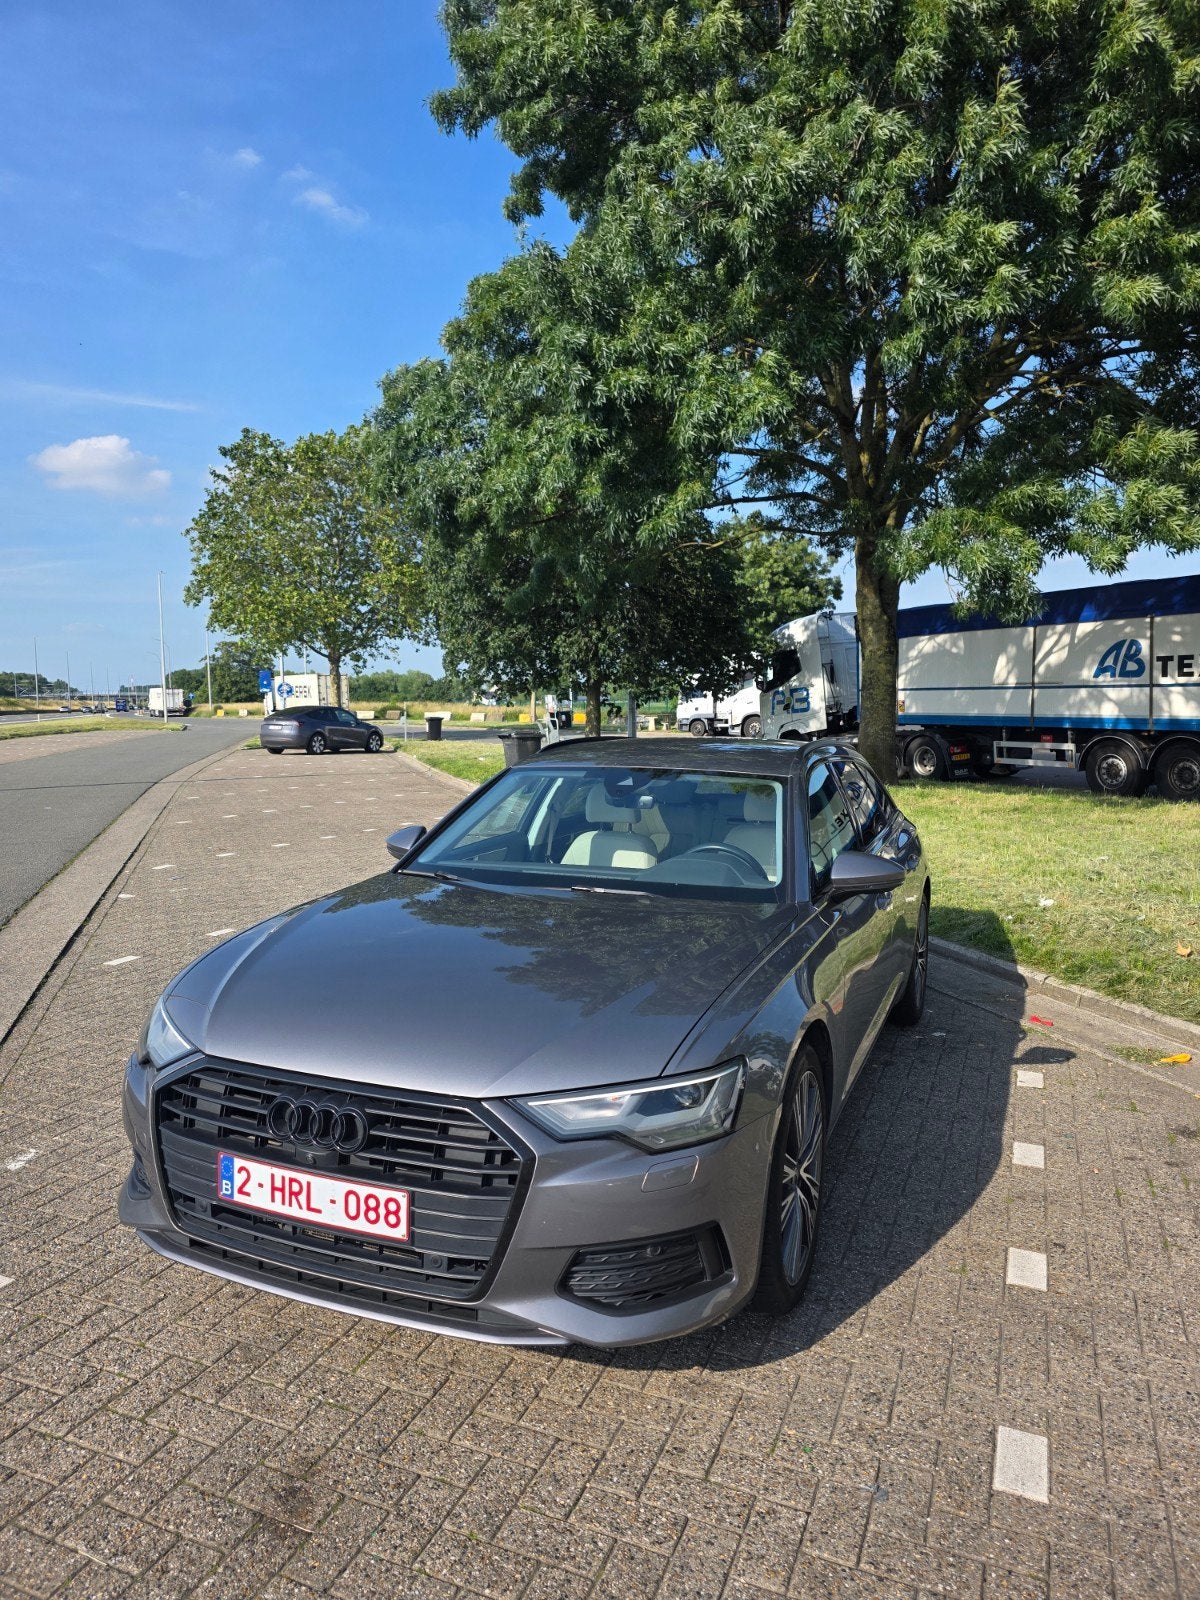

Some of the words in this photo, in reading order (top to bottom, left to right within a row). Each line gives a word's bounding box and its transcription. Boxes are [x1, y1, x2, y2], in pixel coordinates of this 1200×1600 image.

[1093, 638, 1146, 678] AB
[1156, 654, 1200, 678] TE
[221, 1179, 232, 1195] B
[236, 1165, 402, 1229] 2-HRL-088
